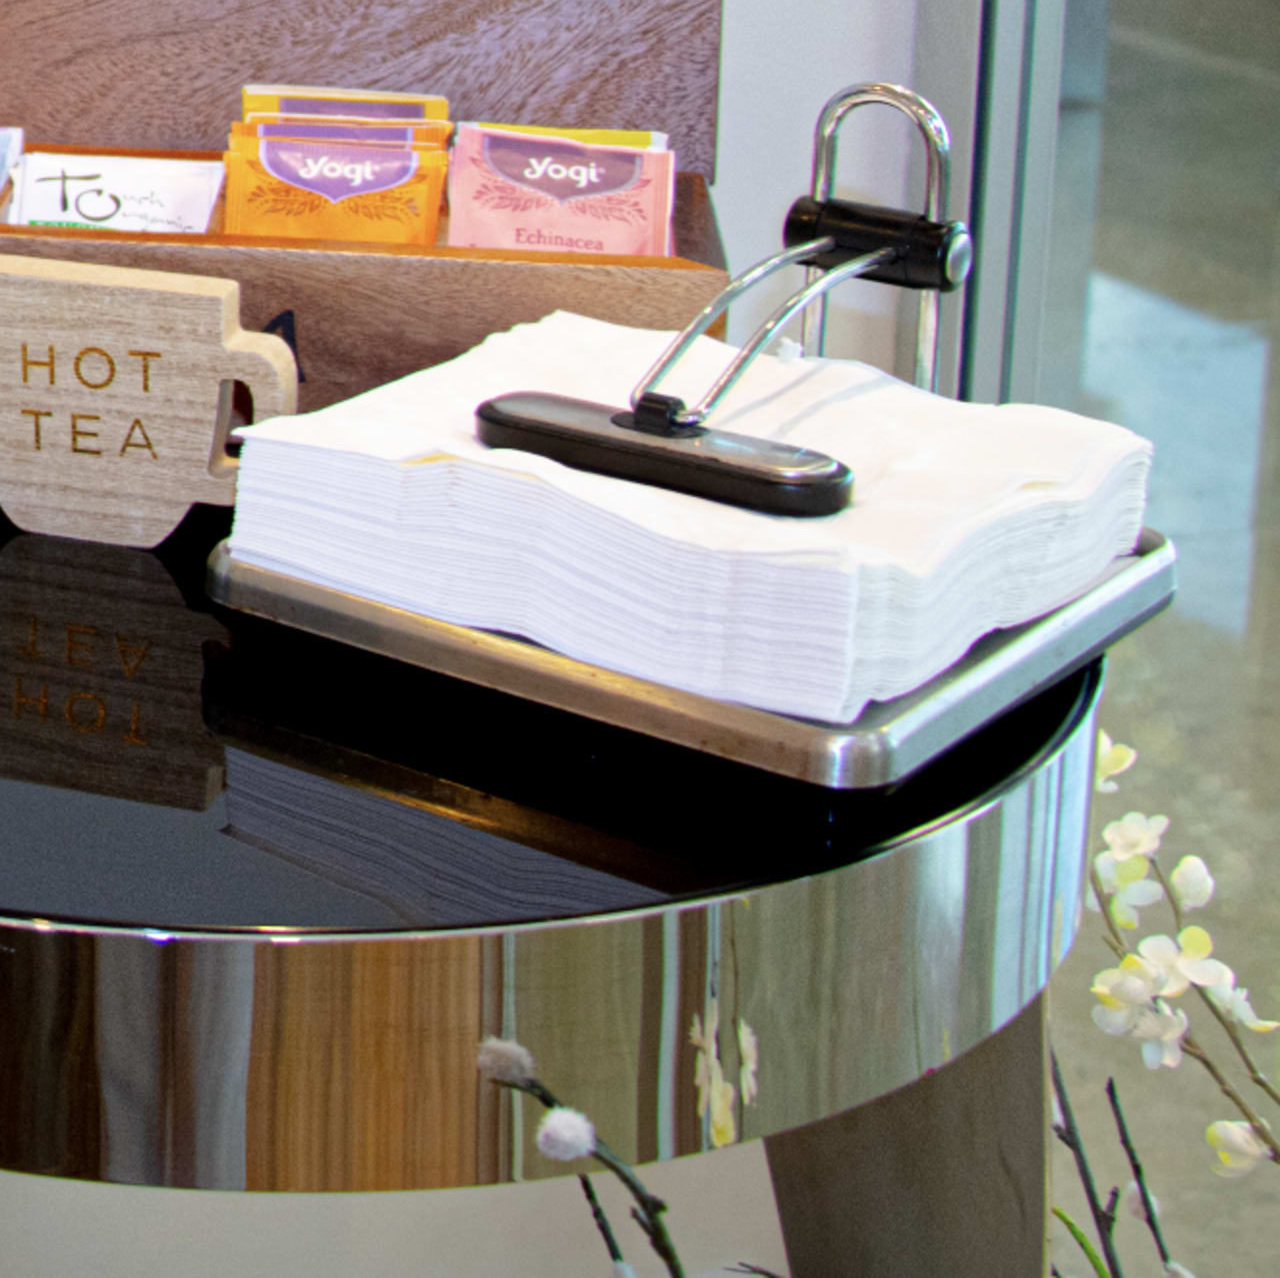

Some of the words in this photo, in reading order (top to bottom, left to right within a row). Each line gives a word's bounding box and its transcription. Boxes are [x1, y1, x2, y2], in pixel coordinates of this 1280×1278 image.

[515, 227, 604, 251] Echinacea
[21, 342, 162, 393] HOT
[20, 409, 158, 460] TEA
